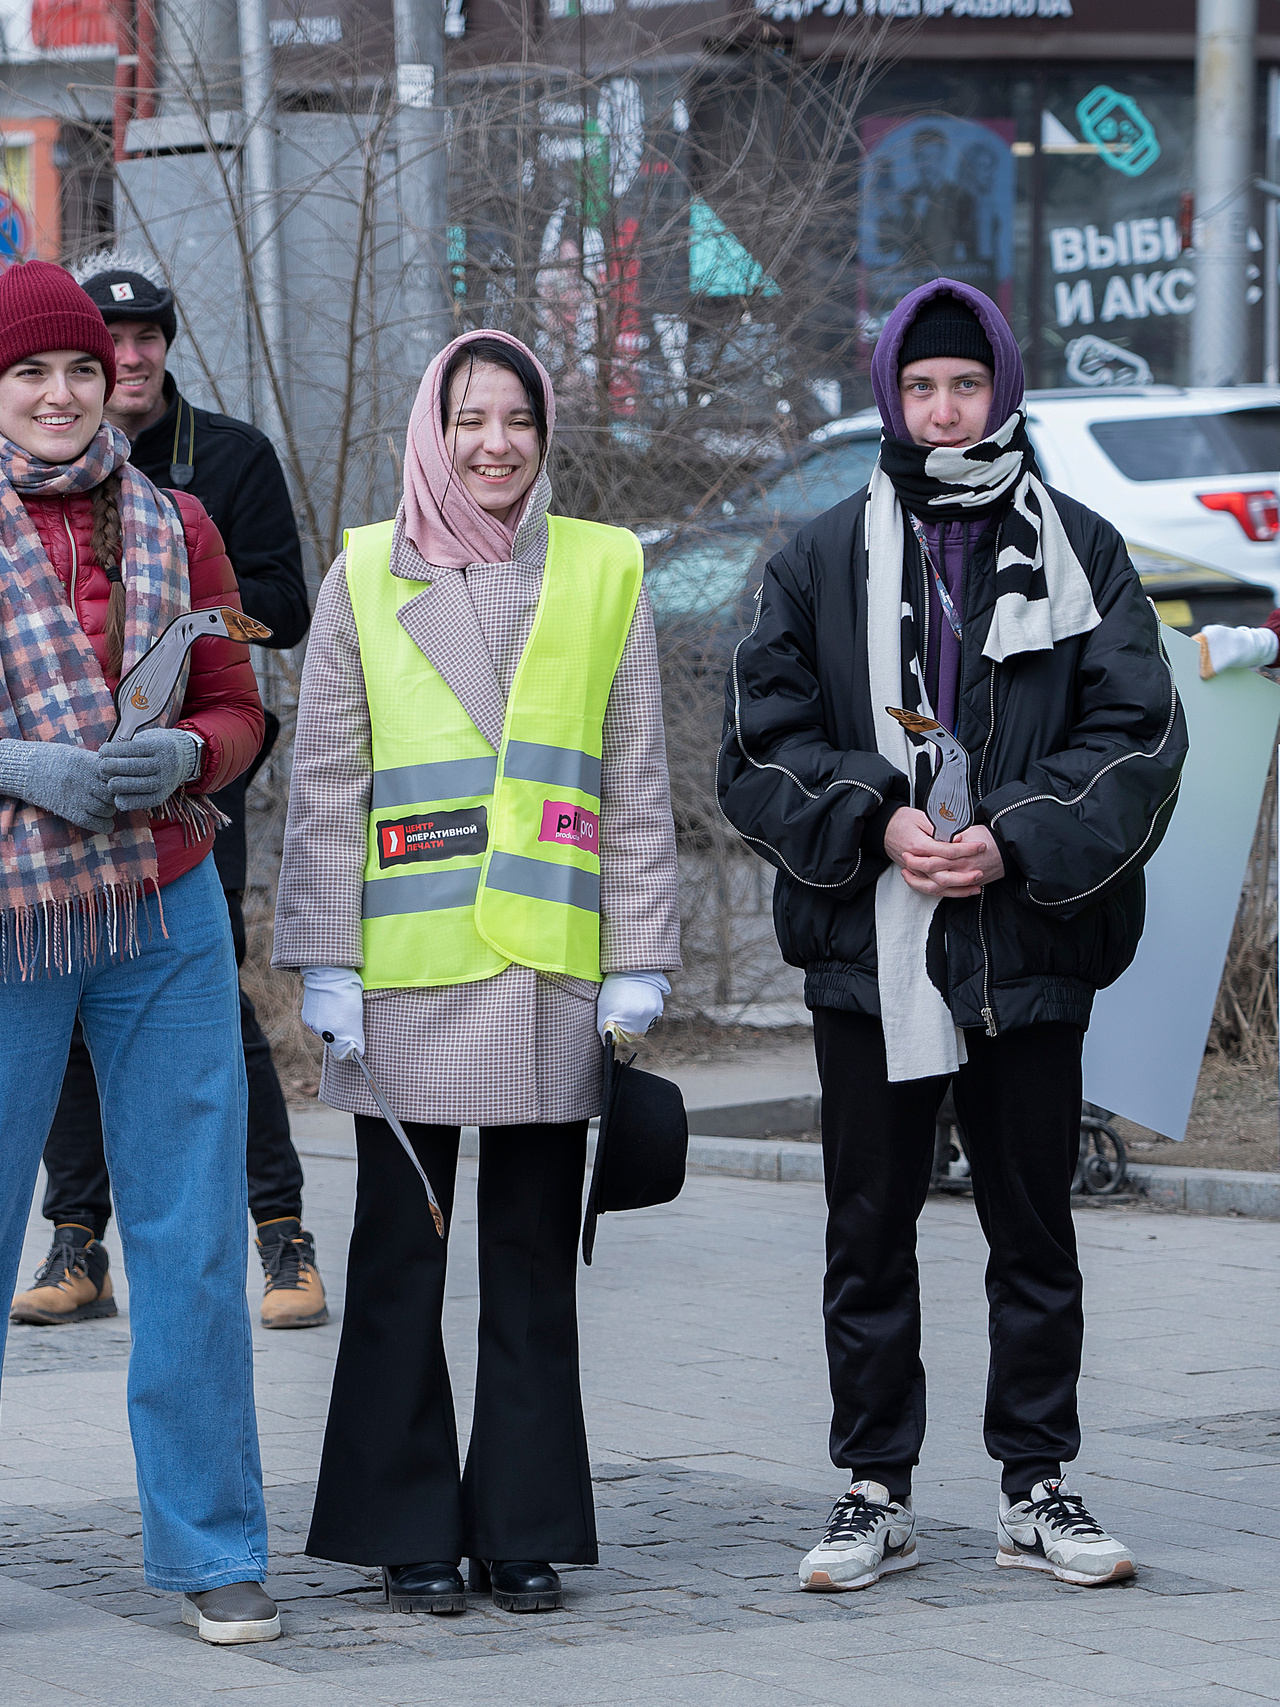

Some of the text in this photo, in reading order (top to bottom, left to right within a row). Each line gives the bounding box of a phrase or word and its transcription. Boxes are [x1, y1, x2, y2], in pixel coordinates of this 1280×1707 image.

[1054, 278, 1096, 328] И
[405, 822, 434, 834] ЦЕНТР
[406, 824, 478, 843] ОПЕРАТИВНОЙ
[406, 839, 444, 852] ПЕЧАТИ
